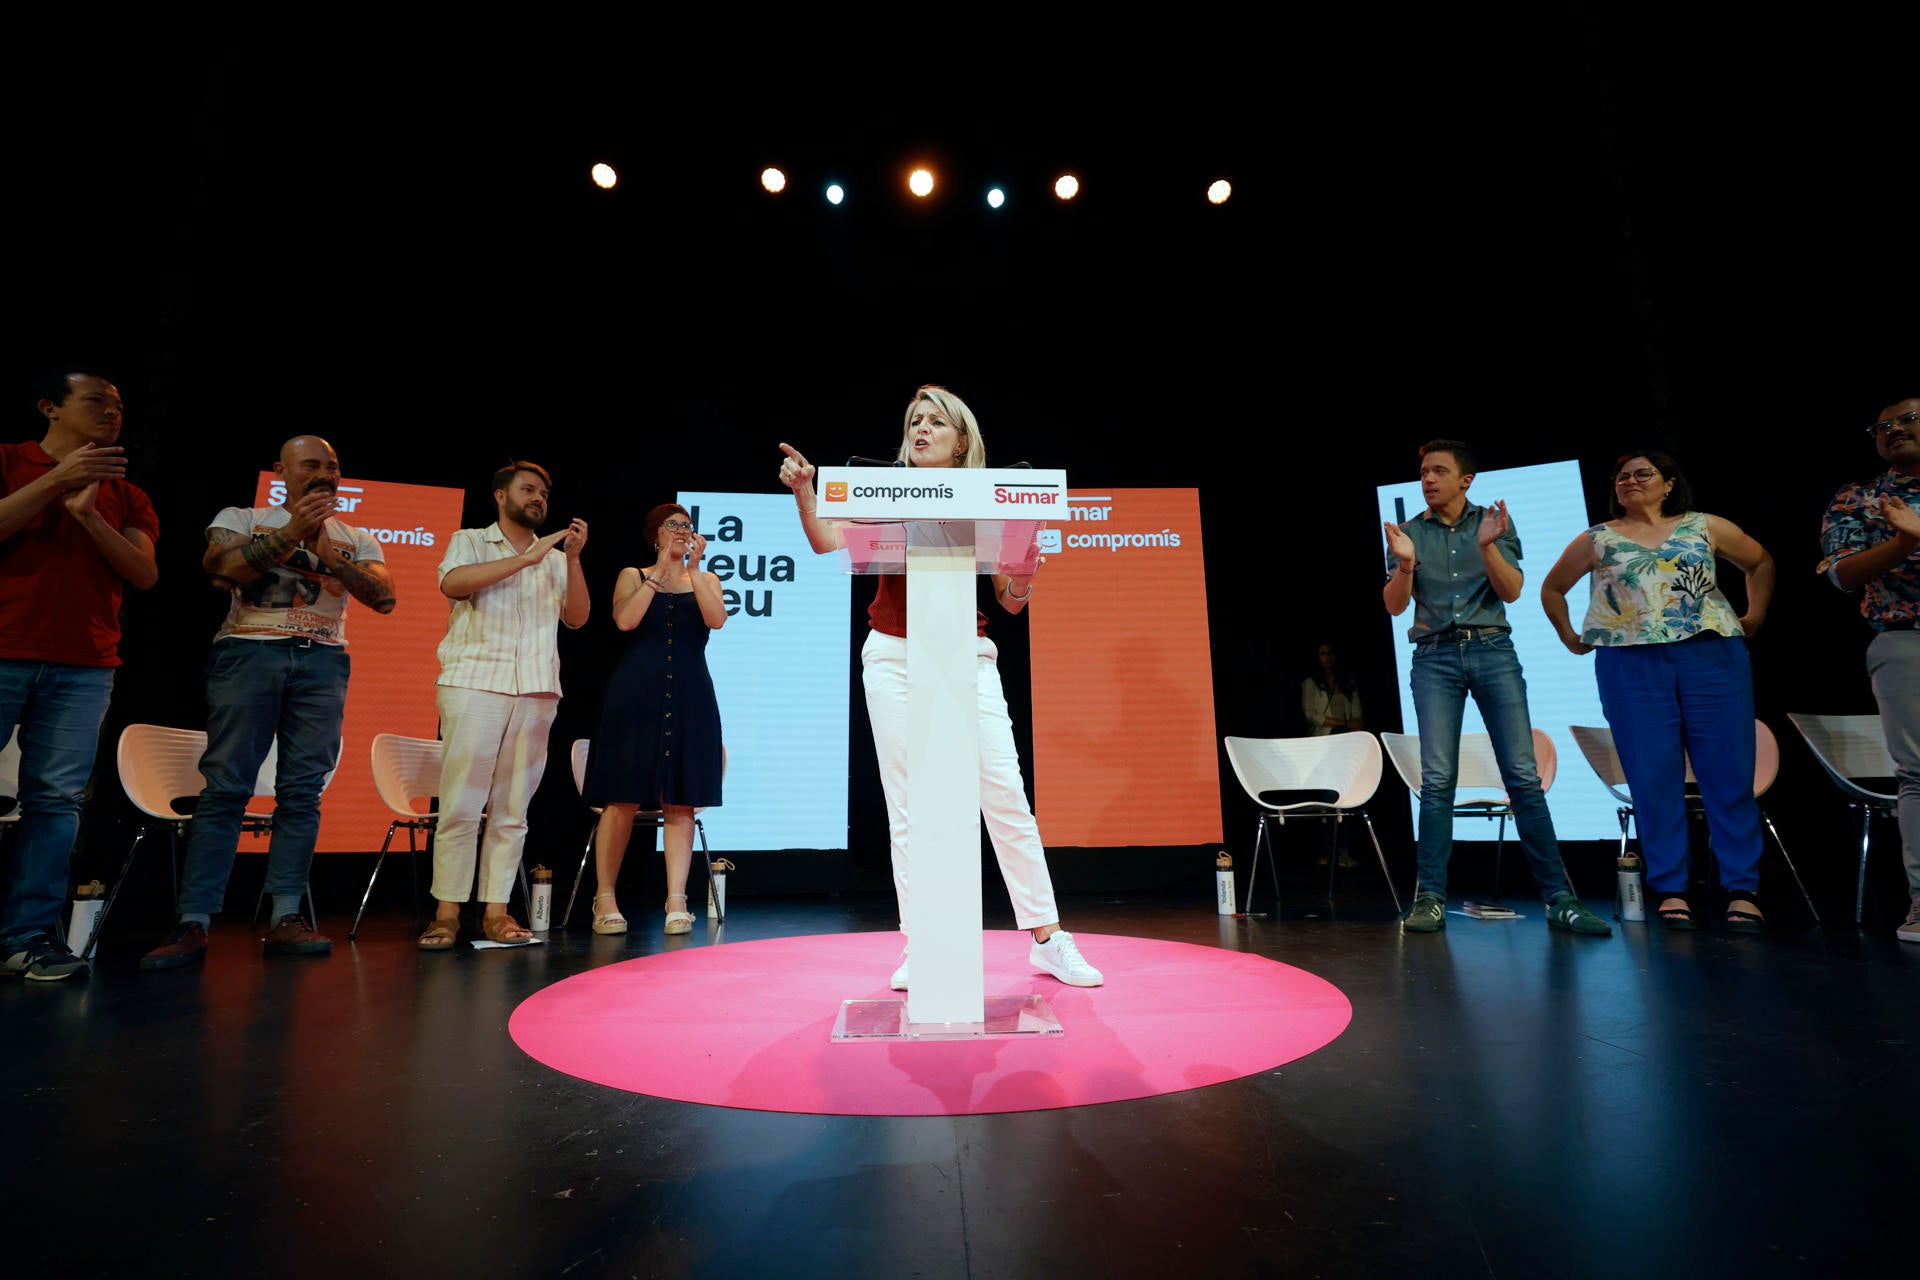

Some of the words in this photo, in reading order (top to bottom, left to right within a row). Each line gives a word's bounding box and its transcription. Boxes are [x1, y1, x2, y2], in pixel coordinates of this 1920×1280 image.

[268, 486, 362, 513] Sar
[853, 483, 954, 502] compromís
[994, 488, 1060, 505] Sumar
[690, 505, 743, 542] La
[1067, 505, 1112, 521] mar
[355, 527, 435, 547] romís
[869, 542, 905, 551] Sum
[1066, 528, 1181, 553] compromís
[722, 588, 773, 617] eu
[536, 895, 544, 920] Alberto
